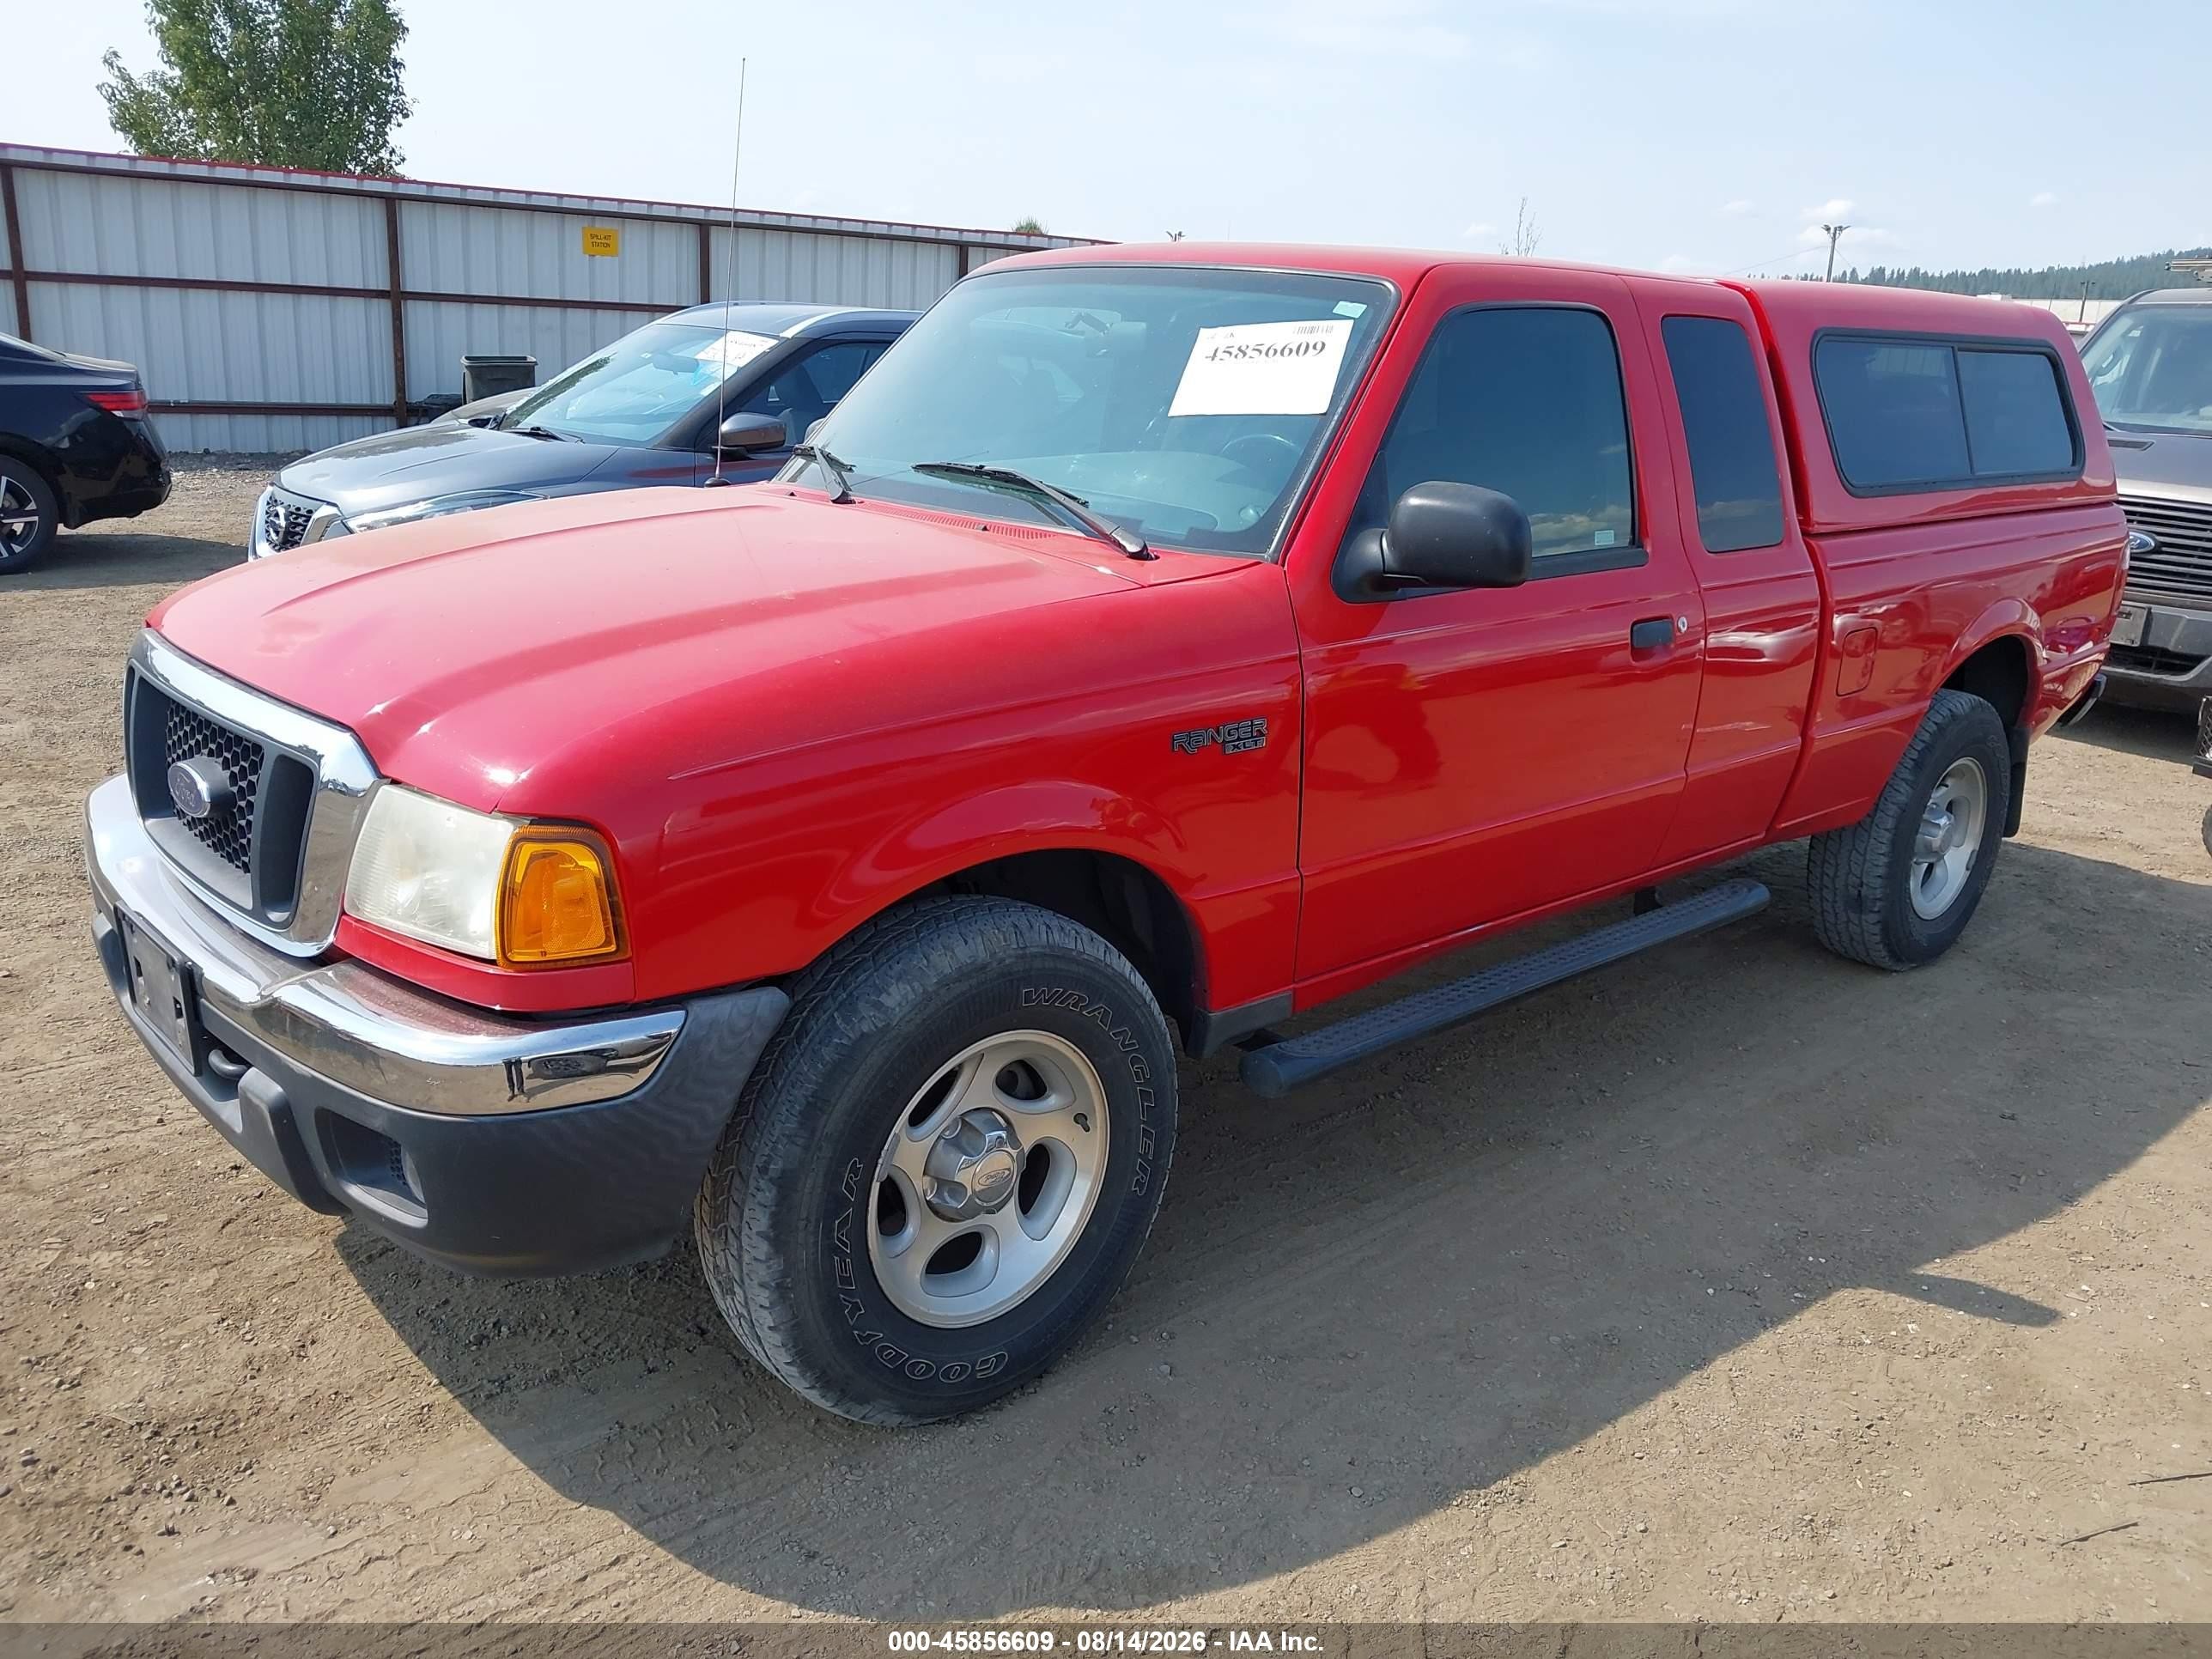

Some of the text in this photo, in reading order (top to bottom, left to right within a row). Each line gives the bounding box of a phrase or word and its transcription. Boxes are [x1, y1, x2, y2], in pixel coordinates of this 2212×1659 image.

[1205, 340, 1327, 362] 45856609
[1231, 738, 1262, 751] XLT
[1023, 987, 1156, 1197] WRANGLER
[835, 1158, 1008, 1382] GOODYEAR
